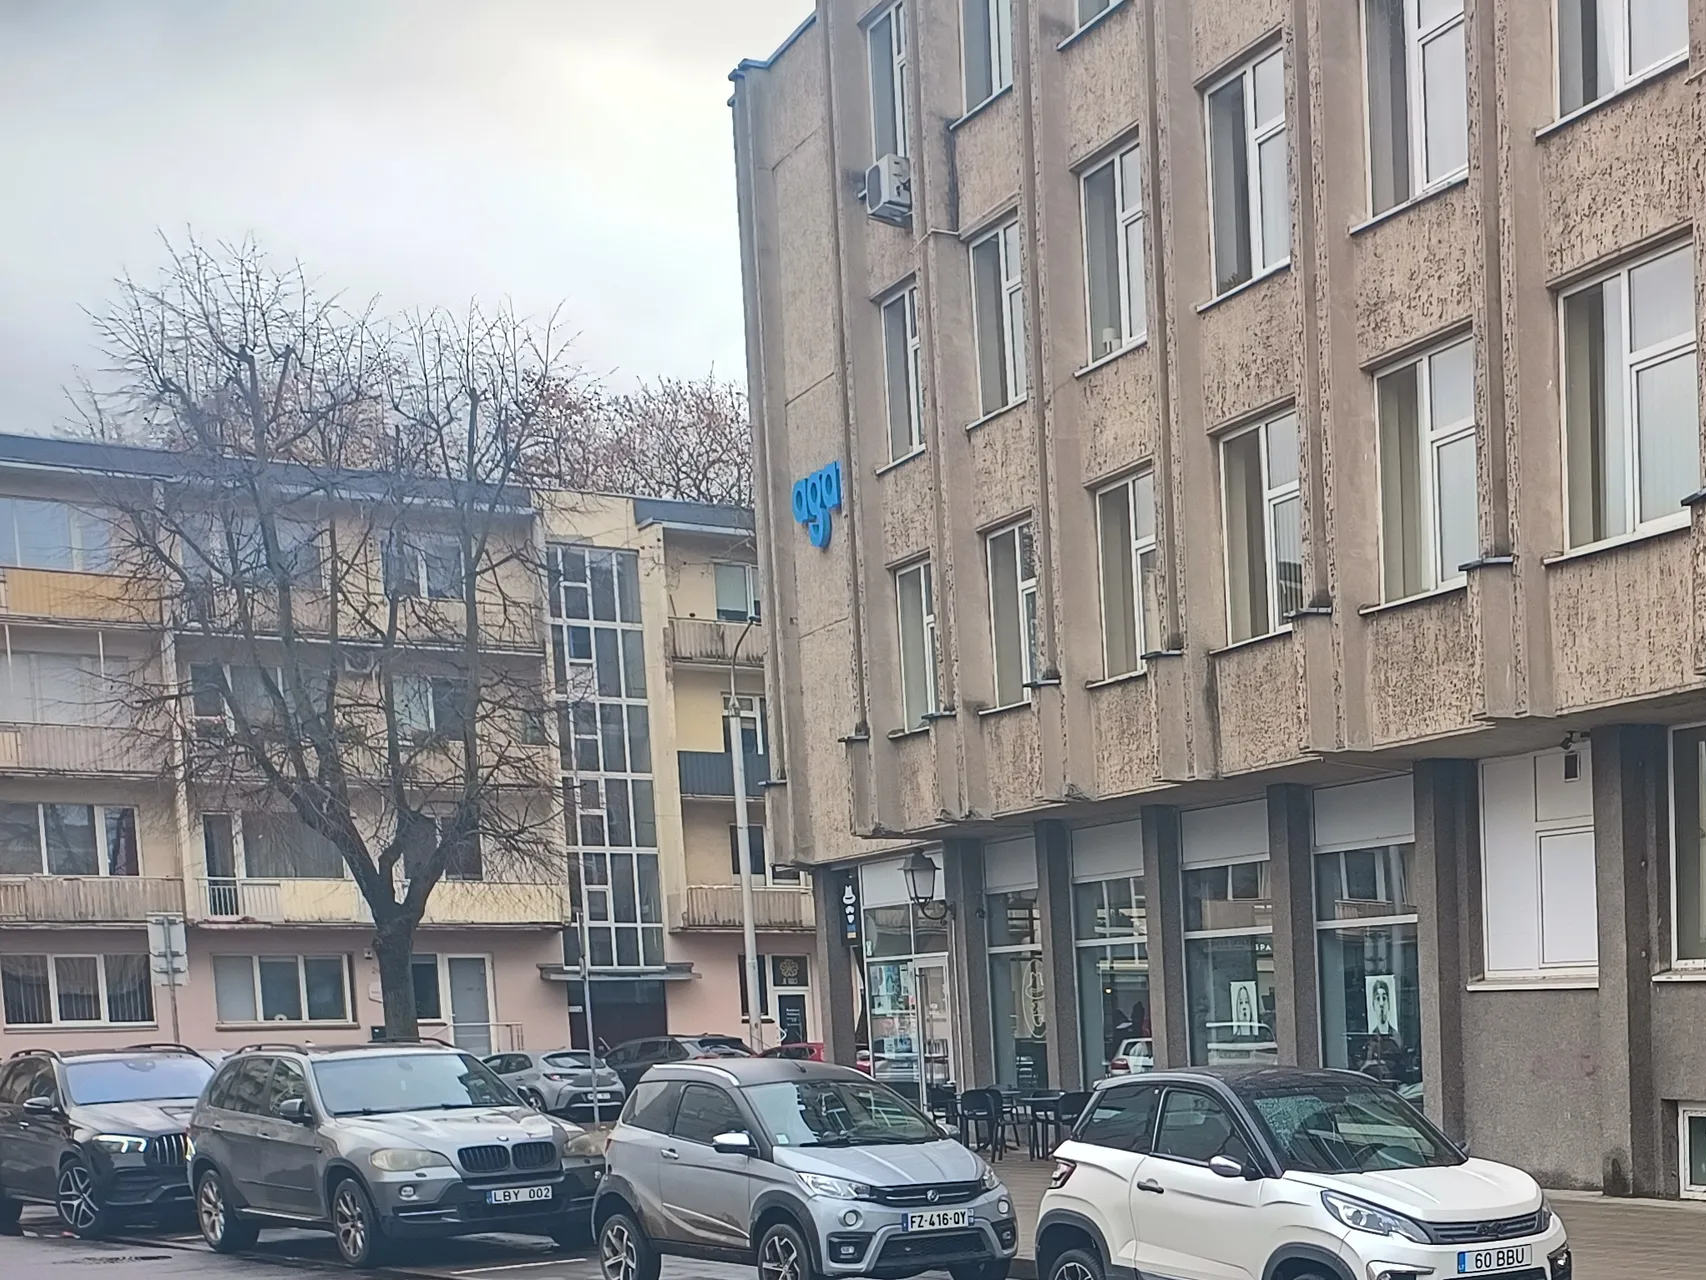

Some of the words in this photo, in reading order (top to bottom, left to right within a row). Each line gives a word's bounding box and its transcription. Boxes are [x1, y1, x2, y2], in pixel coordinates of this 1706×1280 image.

[792, 460, 841, 548] aga
[493, 1189, 520, 1202] LBY
[528, 1186, 550, 1199] 002
[1474, 1252, 1492, 1269] 60
[1496, 1247, 1525, 1267] BBU
